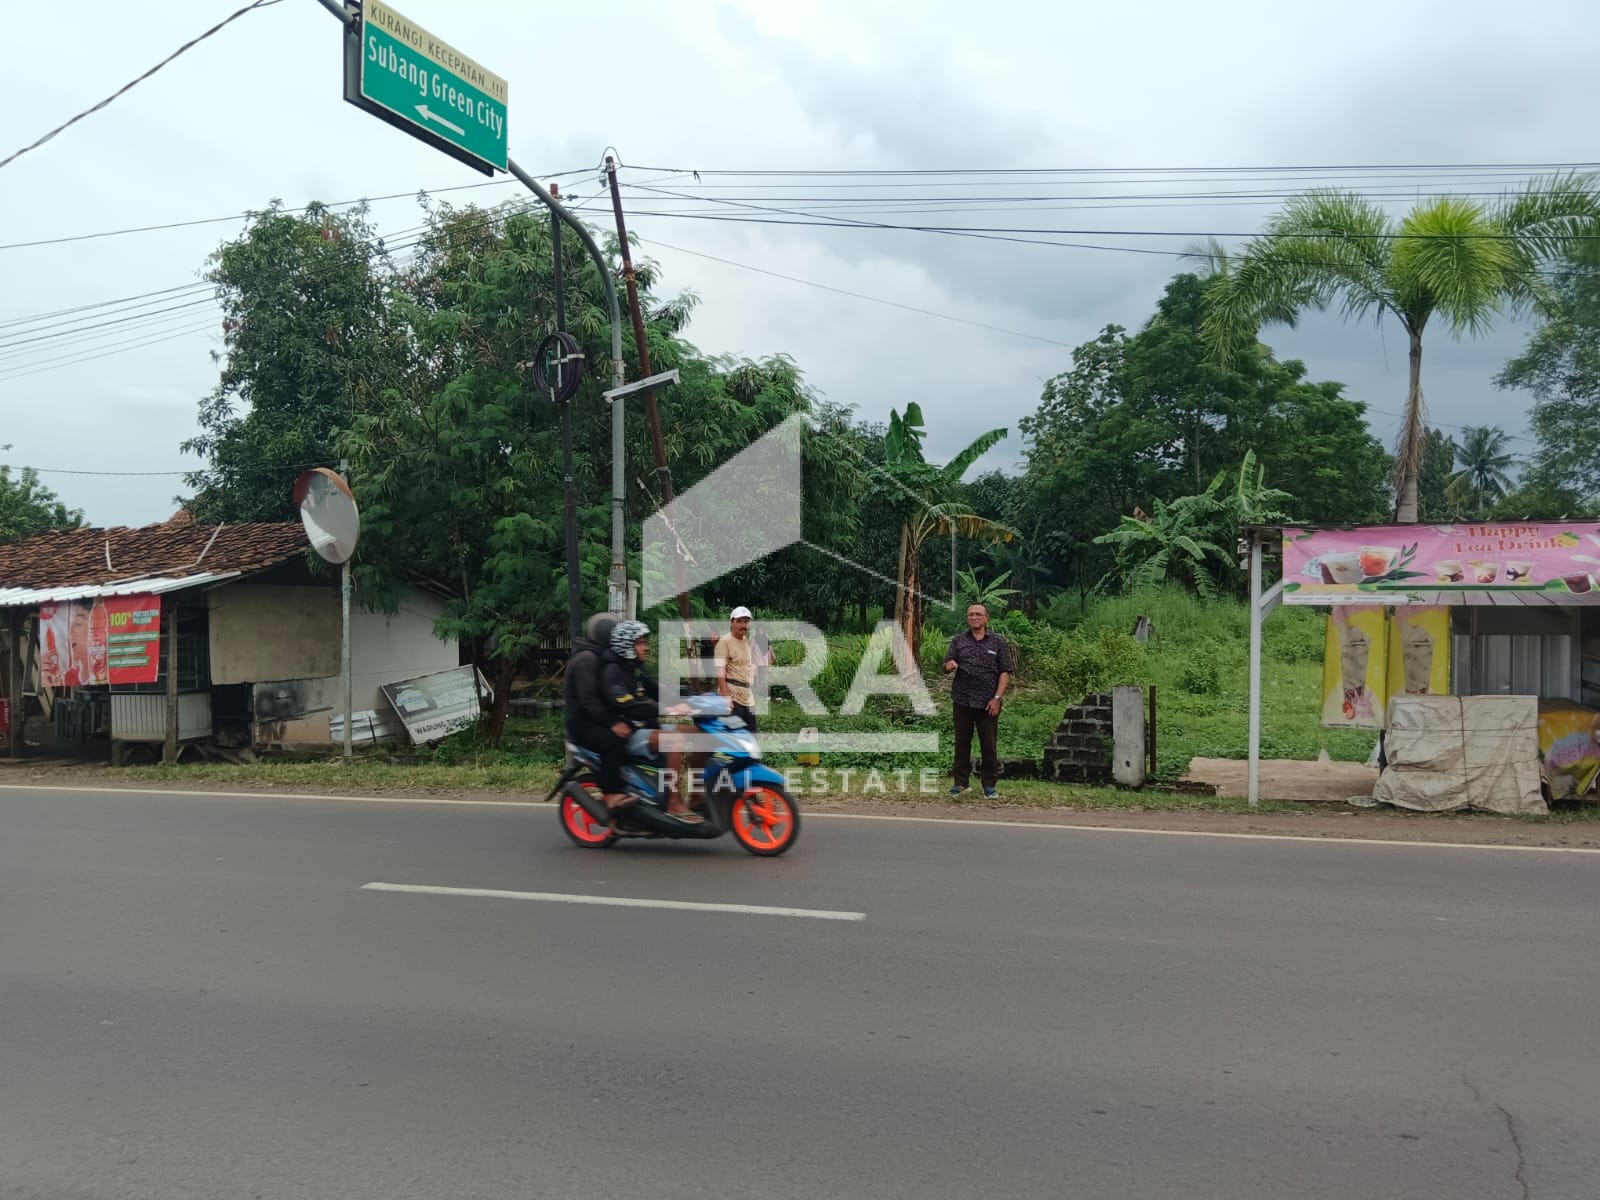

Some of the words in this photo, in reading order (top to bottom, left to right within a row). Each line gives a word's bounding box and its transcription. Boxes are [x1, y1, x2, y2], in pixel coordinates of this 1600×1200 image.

[370, 4, 423, 49] KURANGI
[368, 35, 428, 97] Subang
[432, 73, 474, 118] Green
[477, 100, 503, 139] City
[1451, 542, 1492, 553] Tea
[1498, 537, 1563, 551] Drink
[1468, 527, 1540, 539] Happy
